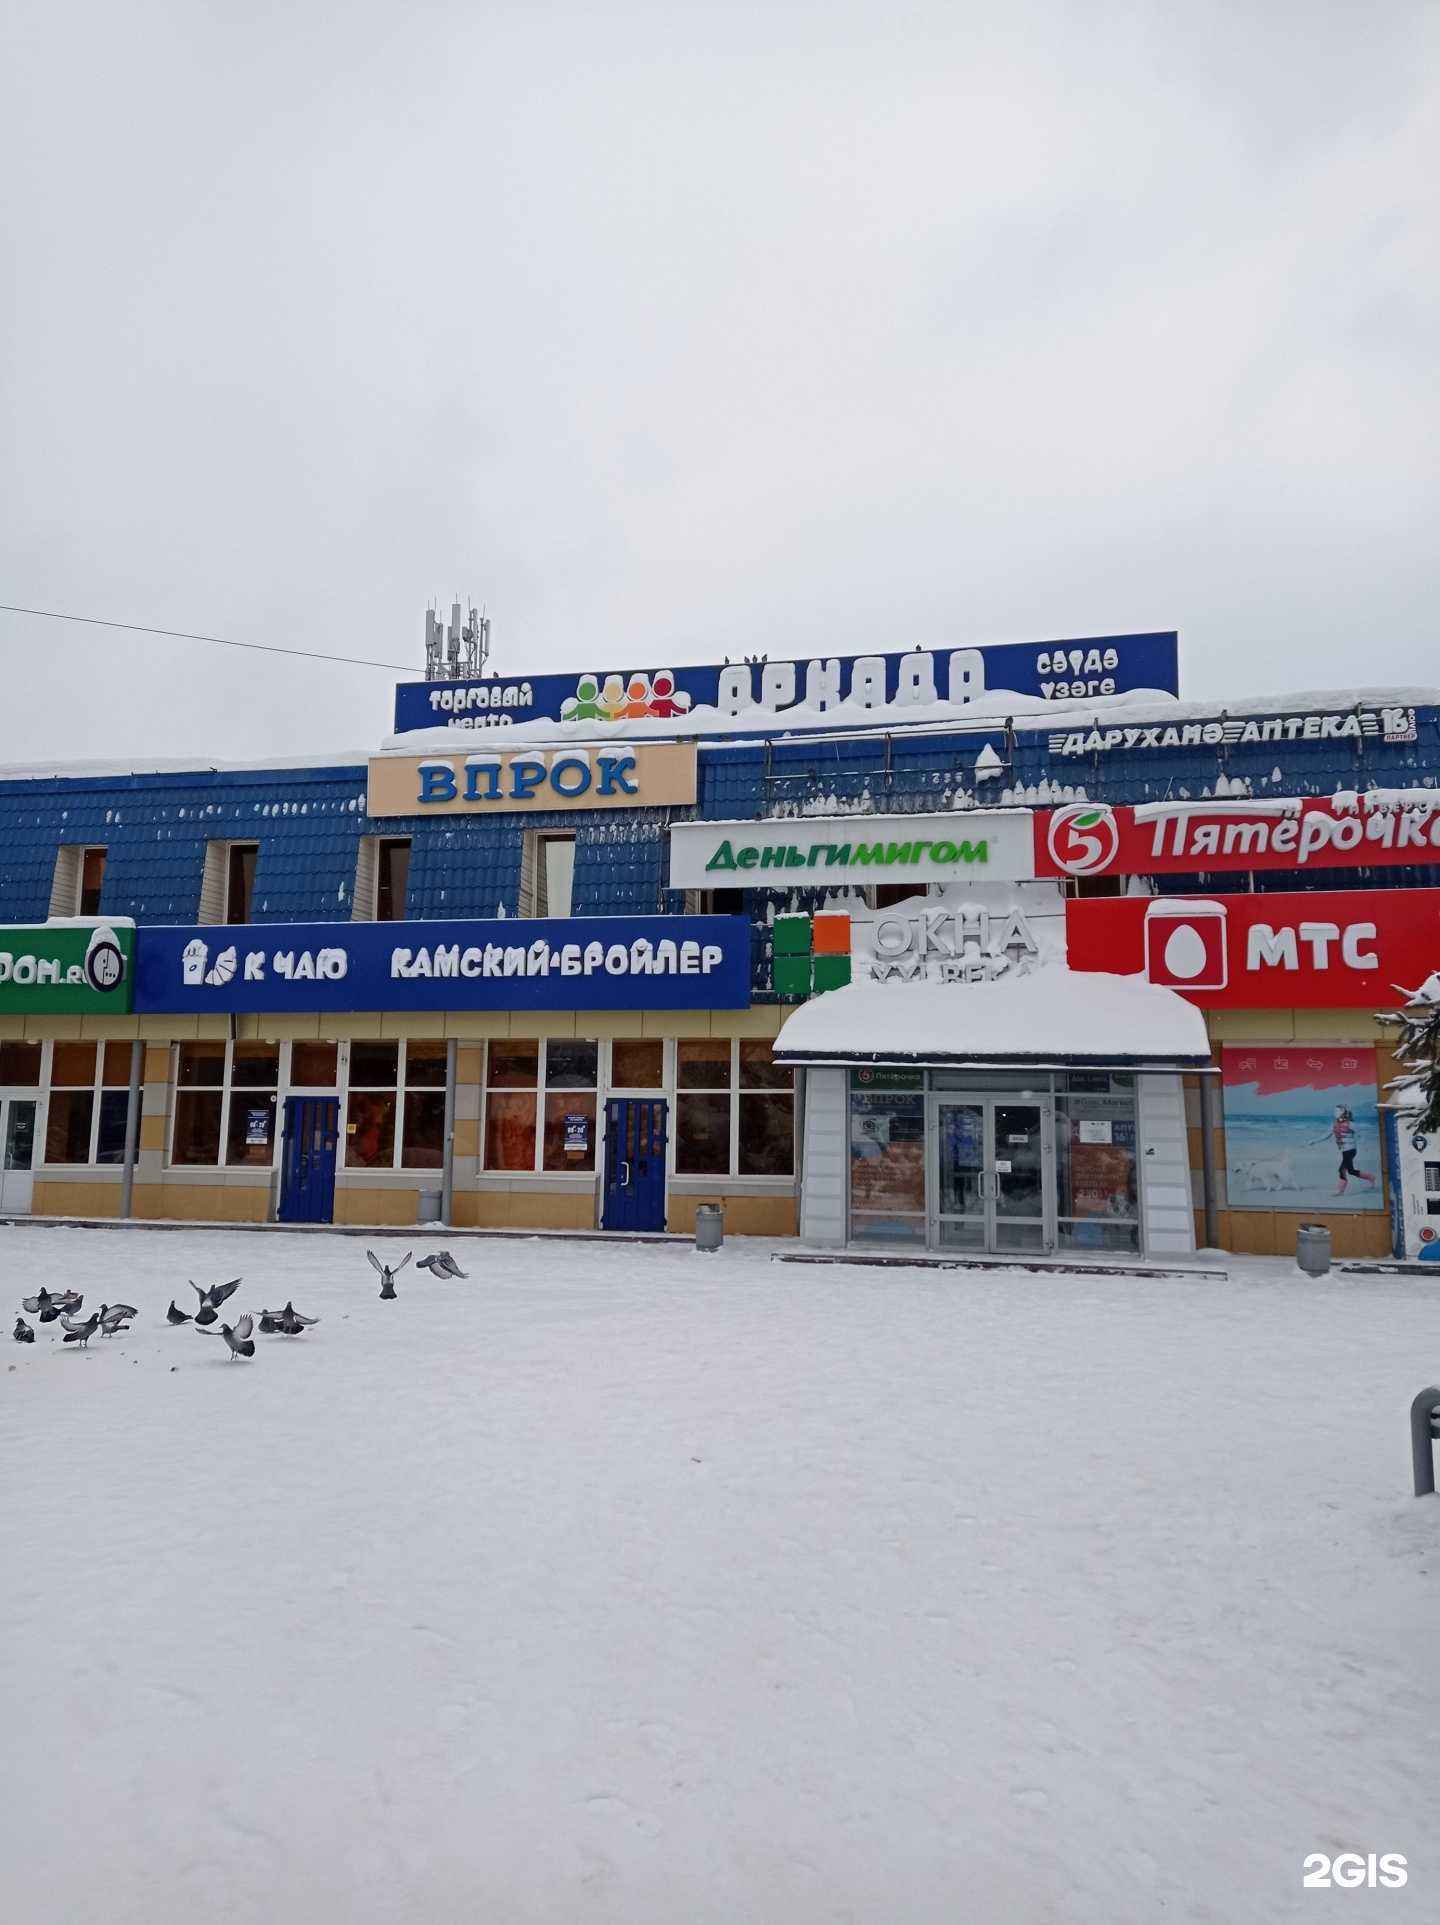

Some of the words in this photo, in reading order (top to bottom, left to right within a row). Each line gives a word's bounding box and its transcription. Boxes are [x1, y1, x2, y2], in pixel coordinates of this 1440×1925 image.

[1238, 714, 1362, 744] АПТЕКА
[417, 753, 640, 802] ВПРОК
[705, 839, 989, 872] Деньгимигом
[872, 904, 1039, 957] ОКНА
[1246, 922, 1380, 972] МТС
[244, 951, 266, 980] К
[273, 948, 348, 980] ЧАЮ
